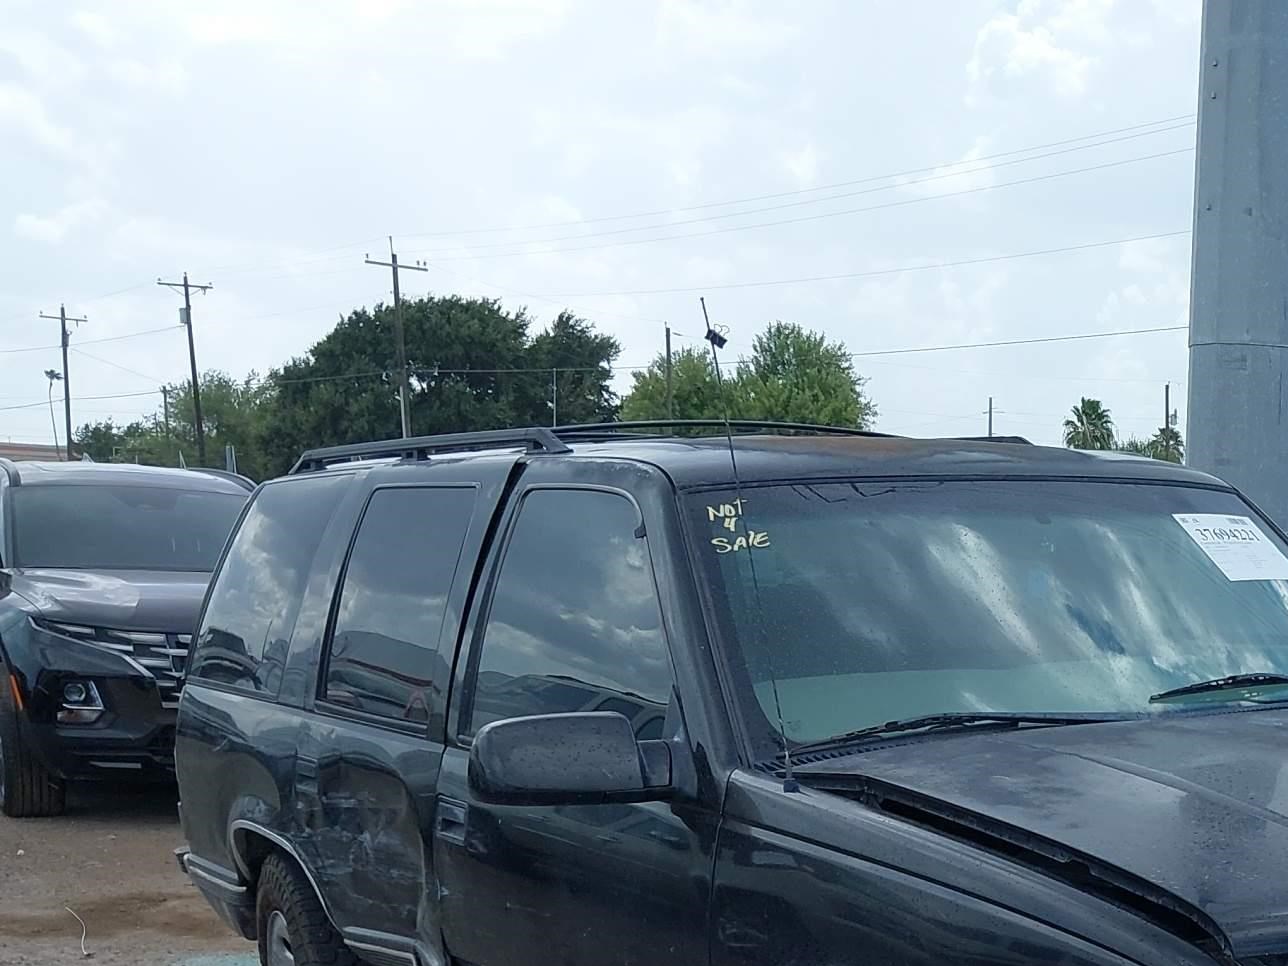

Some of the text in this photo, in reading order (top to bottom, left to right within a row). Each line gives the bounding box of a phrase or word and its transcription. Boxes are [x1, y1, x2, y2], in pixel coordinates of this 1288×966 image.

[706, 498, 748, 521] NOT
[723, 517, 738, 532] 4
[710, 530, 771, 553] SALE
[1195, 528, 1260, 542] 37694221
